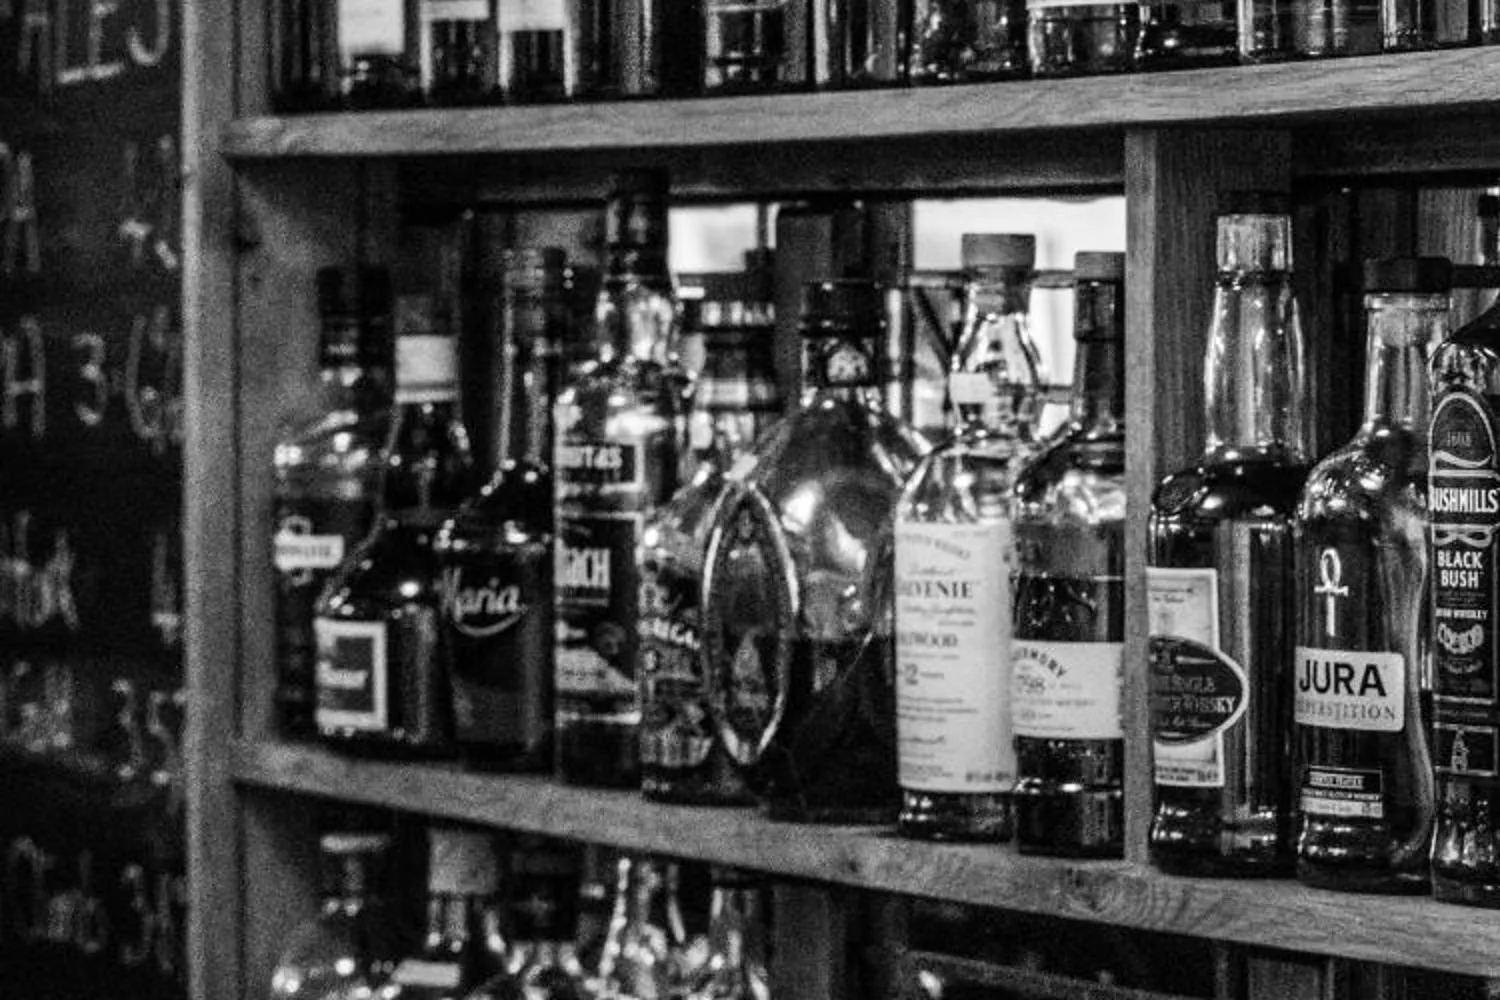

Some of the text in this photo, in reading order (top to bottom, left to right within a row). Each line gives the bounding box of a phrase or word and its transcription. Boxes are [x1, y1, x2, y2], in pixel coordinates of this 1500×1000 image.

[1437, 550, 1483, 569] BLACK
[1441, 569, 1479, 589] BUSH
[1299, 658, 1388, 698] JURA
